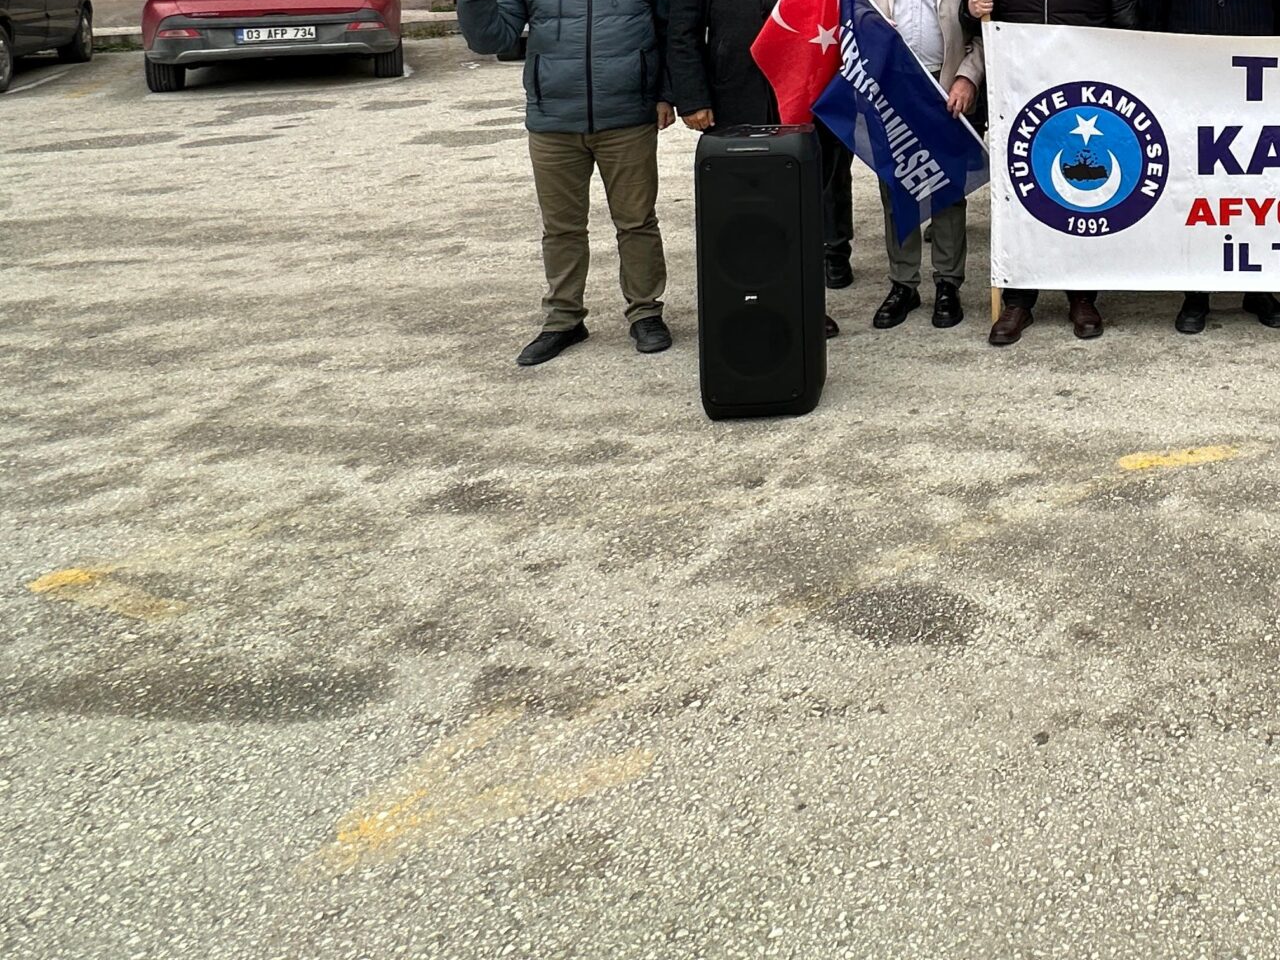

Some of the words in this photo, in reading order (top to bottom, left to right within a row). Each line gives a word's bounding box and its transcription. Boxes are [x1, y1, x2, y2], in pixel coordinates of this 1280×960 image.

[246, 29, 261, 39] 03
[267, 28, 288, 39] AFP
[294, 27, 314, 38] 734
[1010, 90, 1068, 197] TÜRKİYE
[1081, 86, 1163, 198] KAMU-SEN
[1067, 216, 1110, 234] 1992
[1223, 234, 1263, 272] İL
